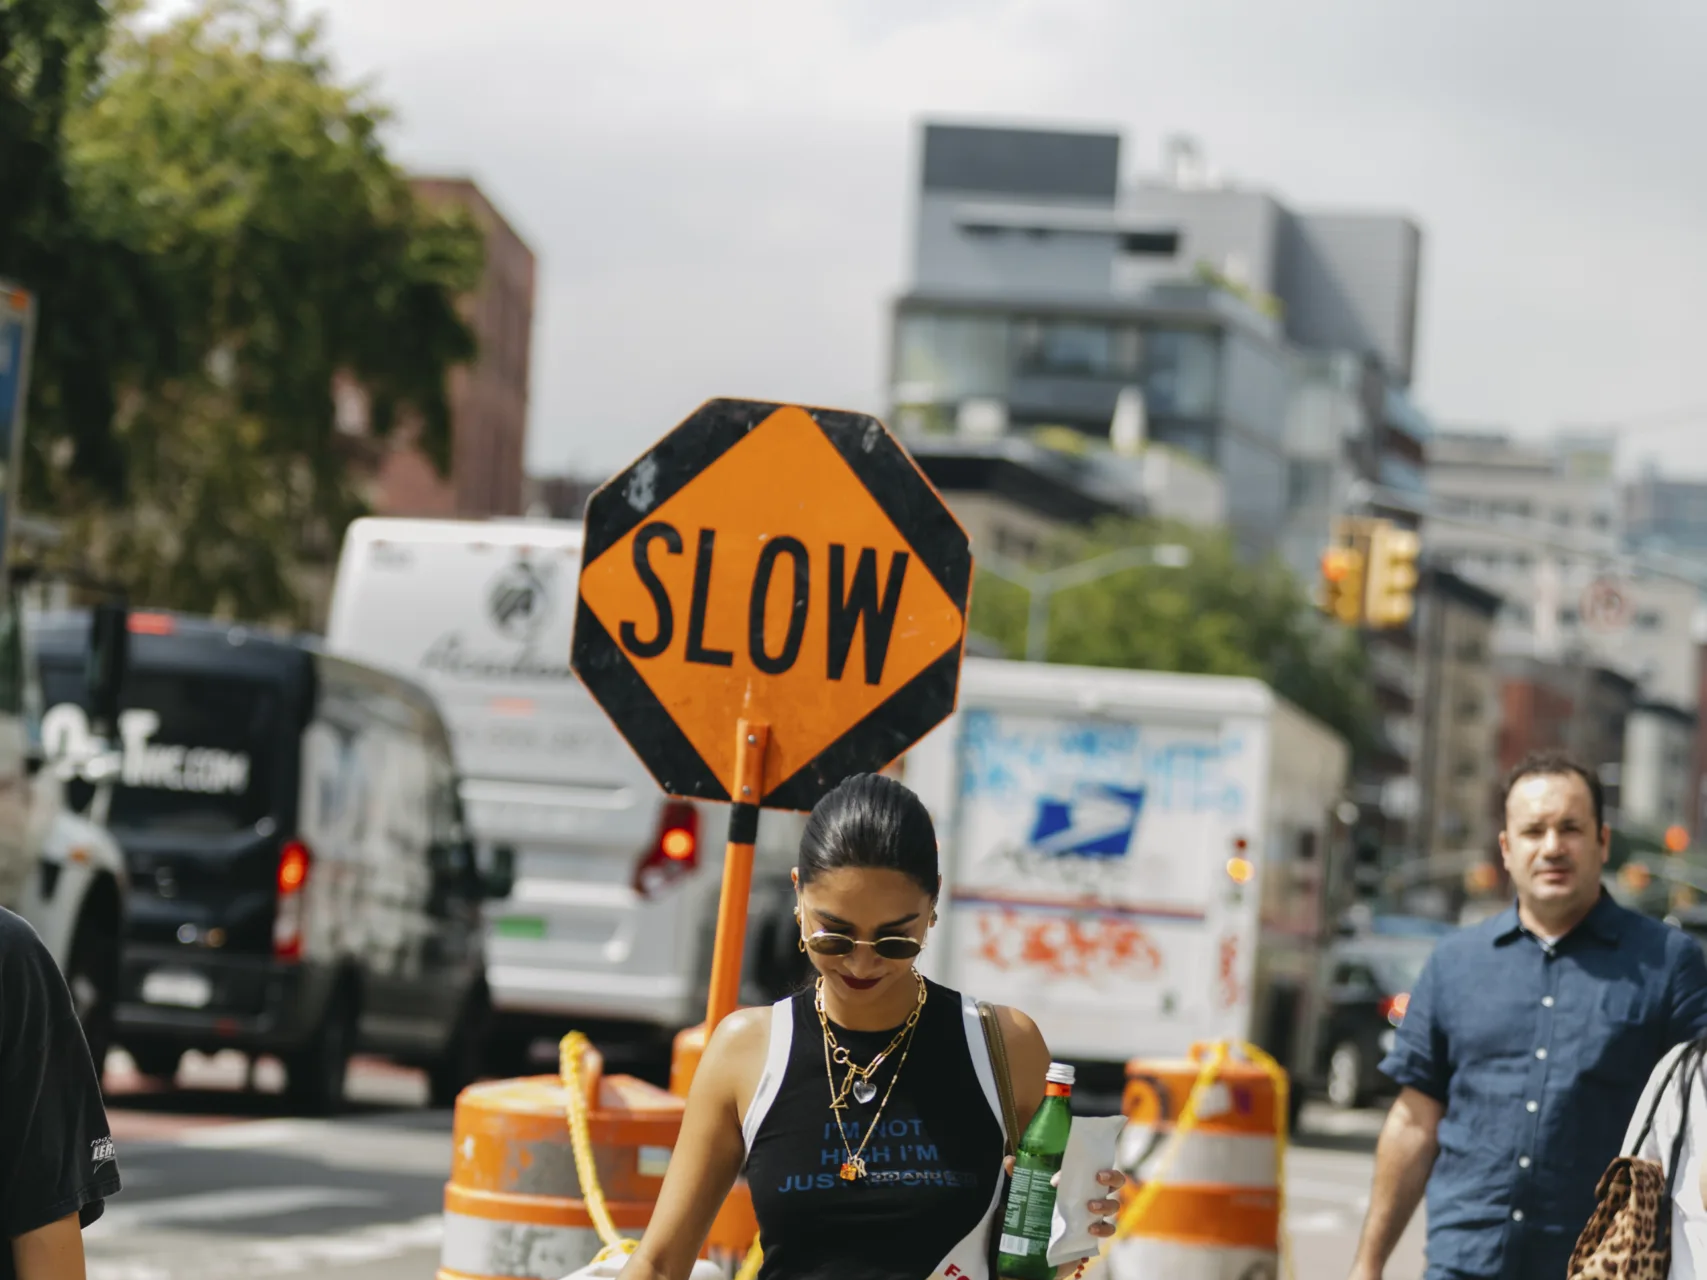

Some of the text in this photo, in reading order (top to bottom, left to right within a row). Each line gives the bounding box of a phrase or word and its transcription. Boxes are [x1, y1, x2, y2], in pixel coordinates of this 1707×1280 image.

[619, 521, 909, 686] SLOW
[823, 1118, 923, 1140] I'M NOT
[900, 1144, 938, 1162] I'M
[778, 1173, 848, 1193] JUS
